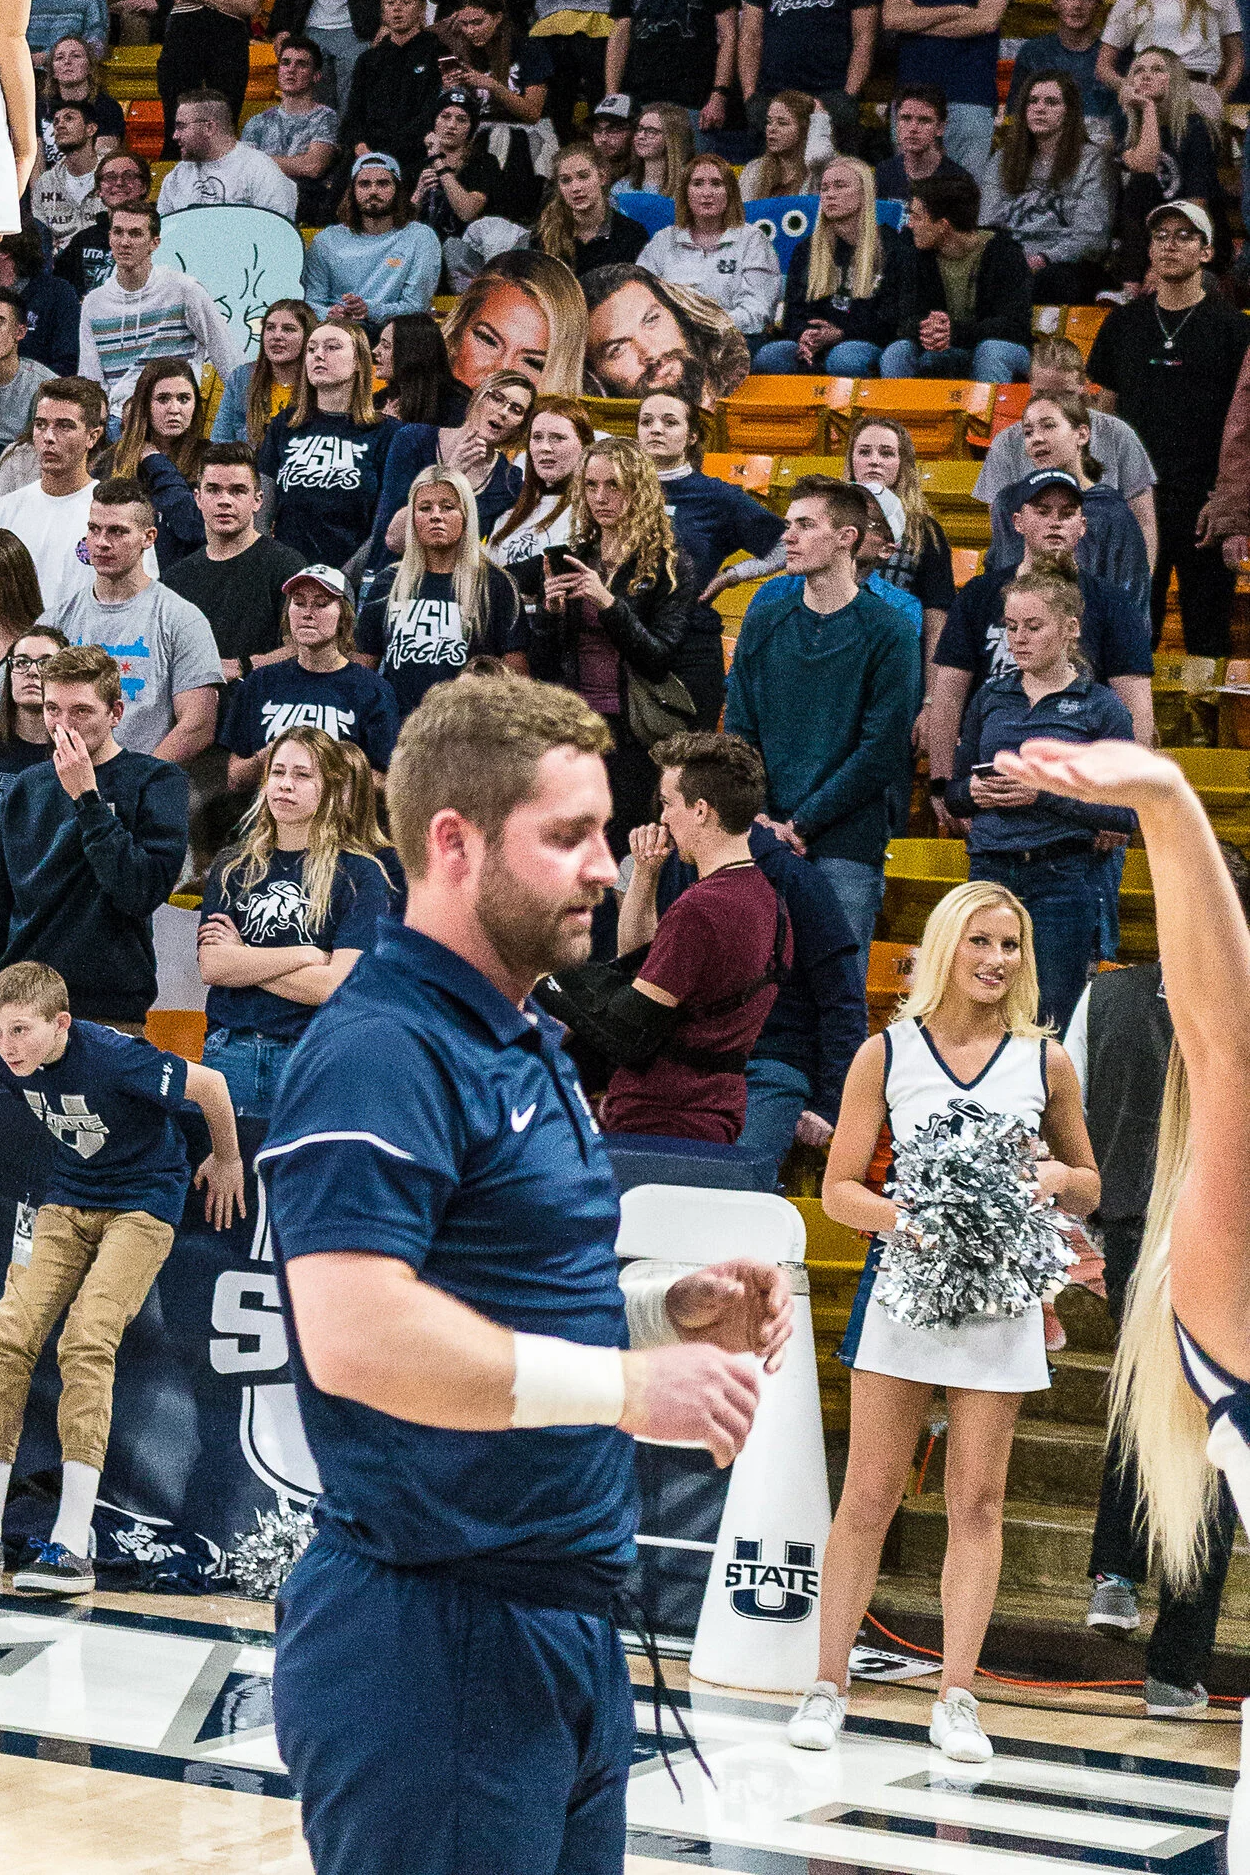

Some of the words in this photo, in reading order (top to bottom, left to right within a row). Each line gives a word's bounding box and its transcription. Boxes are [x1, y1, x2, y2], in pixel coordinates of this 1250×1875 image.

[286, 434, 362, 470] USU
[277, 464, 362, 492] AGGIES
[390, 599, 463, 641] USU
[386, 632, 469, 670] AGGIES
[725, 1562, 820, 1598] STATE
